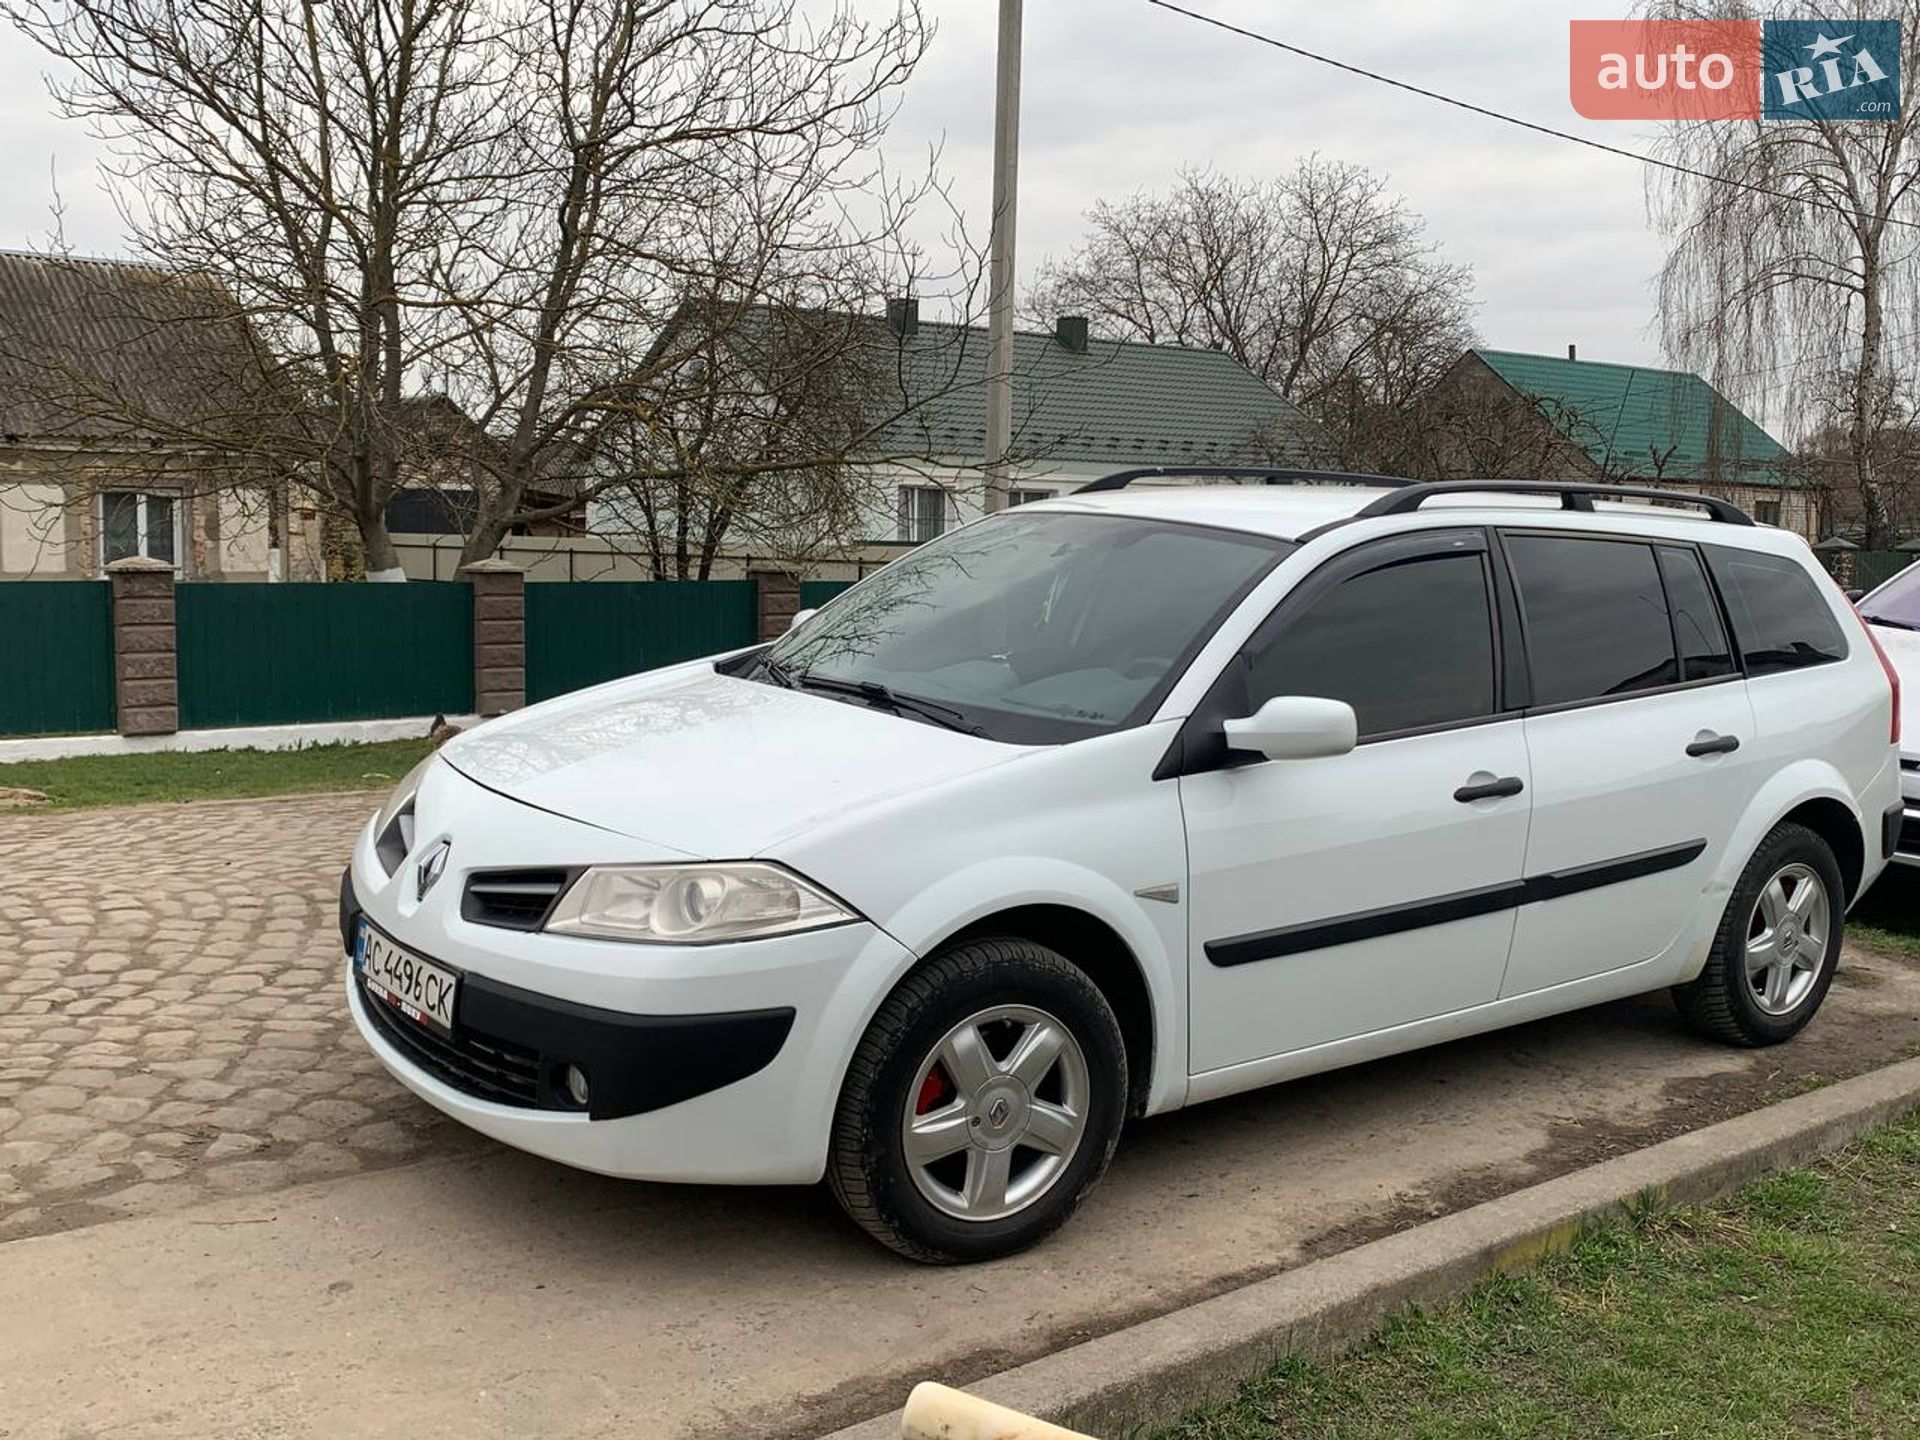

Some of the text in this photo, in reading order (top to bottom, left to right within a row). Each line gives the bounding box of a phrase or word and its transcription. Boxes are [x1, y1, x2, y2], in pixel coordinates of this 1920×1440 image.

[364, 933, 382, 977] AC
[384, 949, 424, 1003] 4496
[425, 973, 453, 1022] CK
